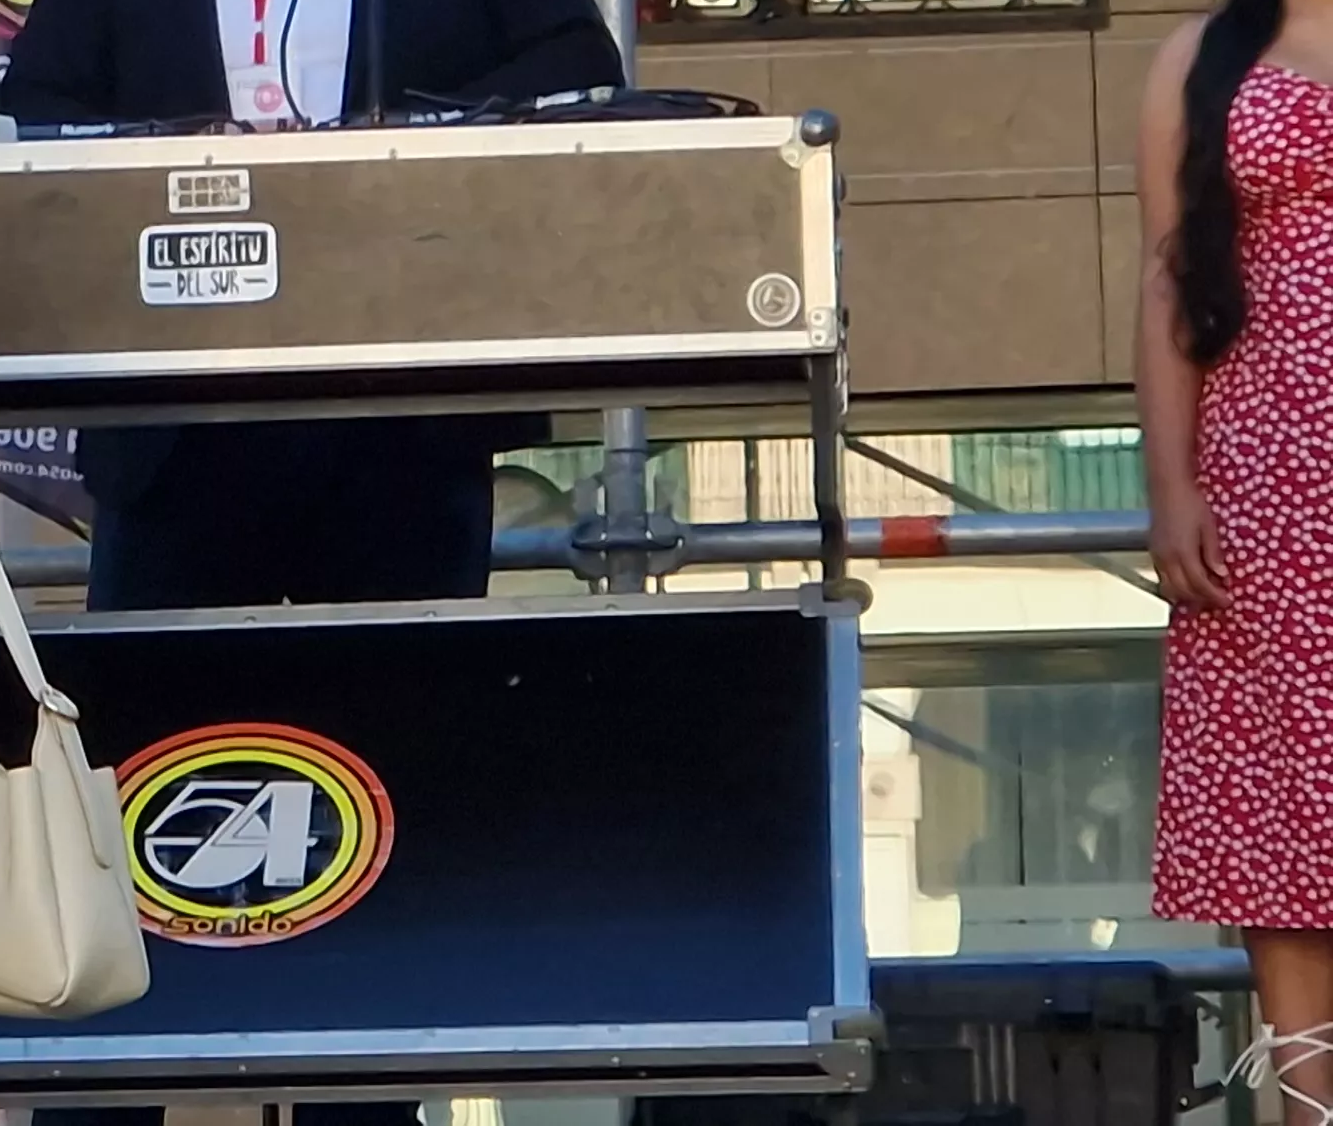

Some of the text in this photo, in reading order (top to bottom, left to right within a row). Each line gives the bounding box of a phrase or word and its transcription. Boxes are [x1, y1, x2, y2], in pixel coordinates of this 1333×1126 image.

[153, 236, 175, 267] EL
[176, 269, 241, 298] DEL SUR
[144, 780, 319, 888] 54
[163, 910, 293, 936] sonido
